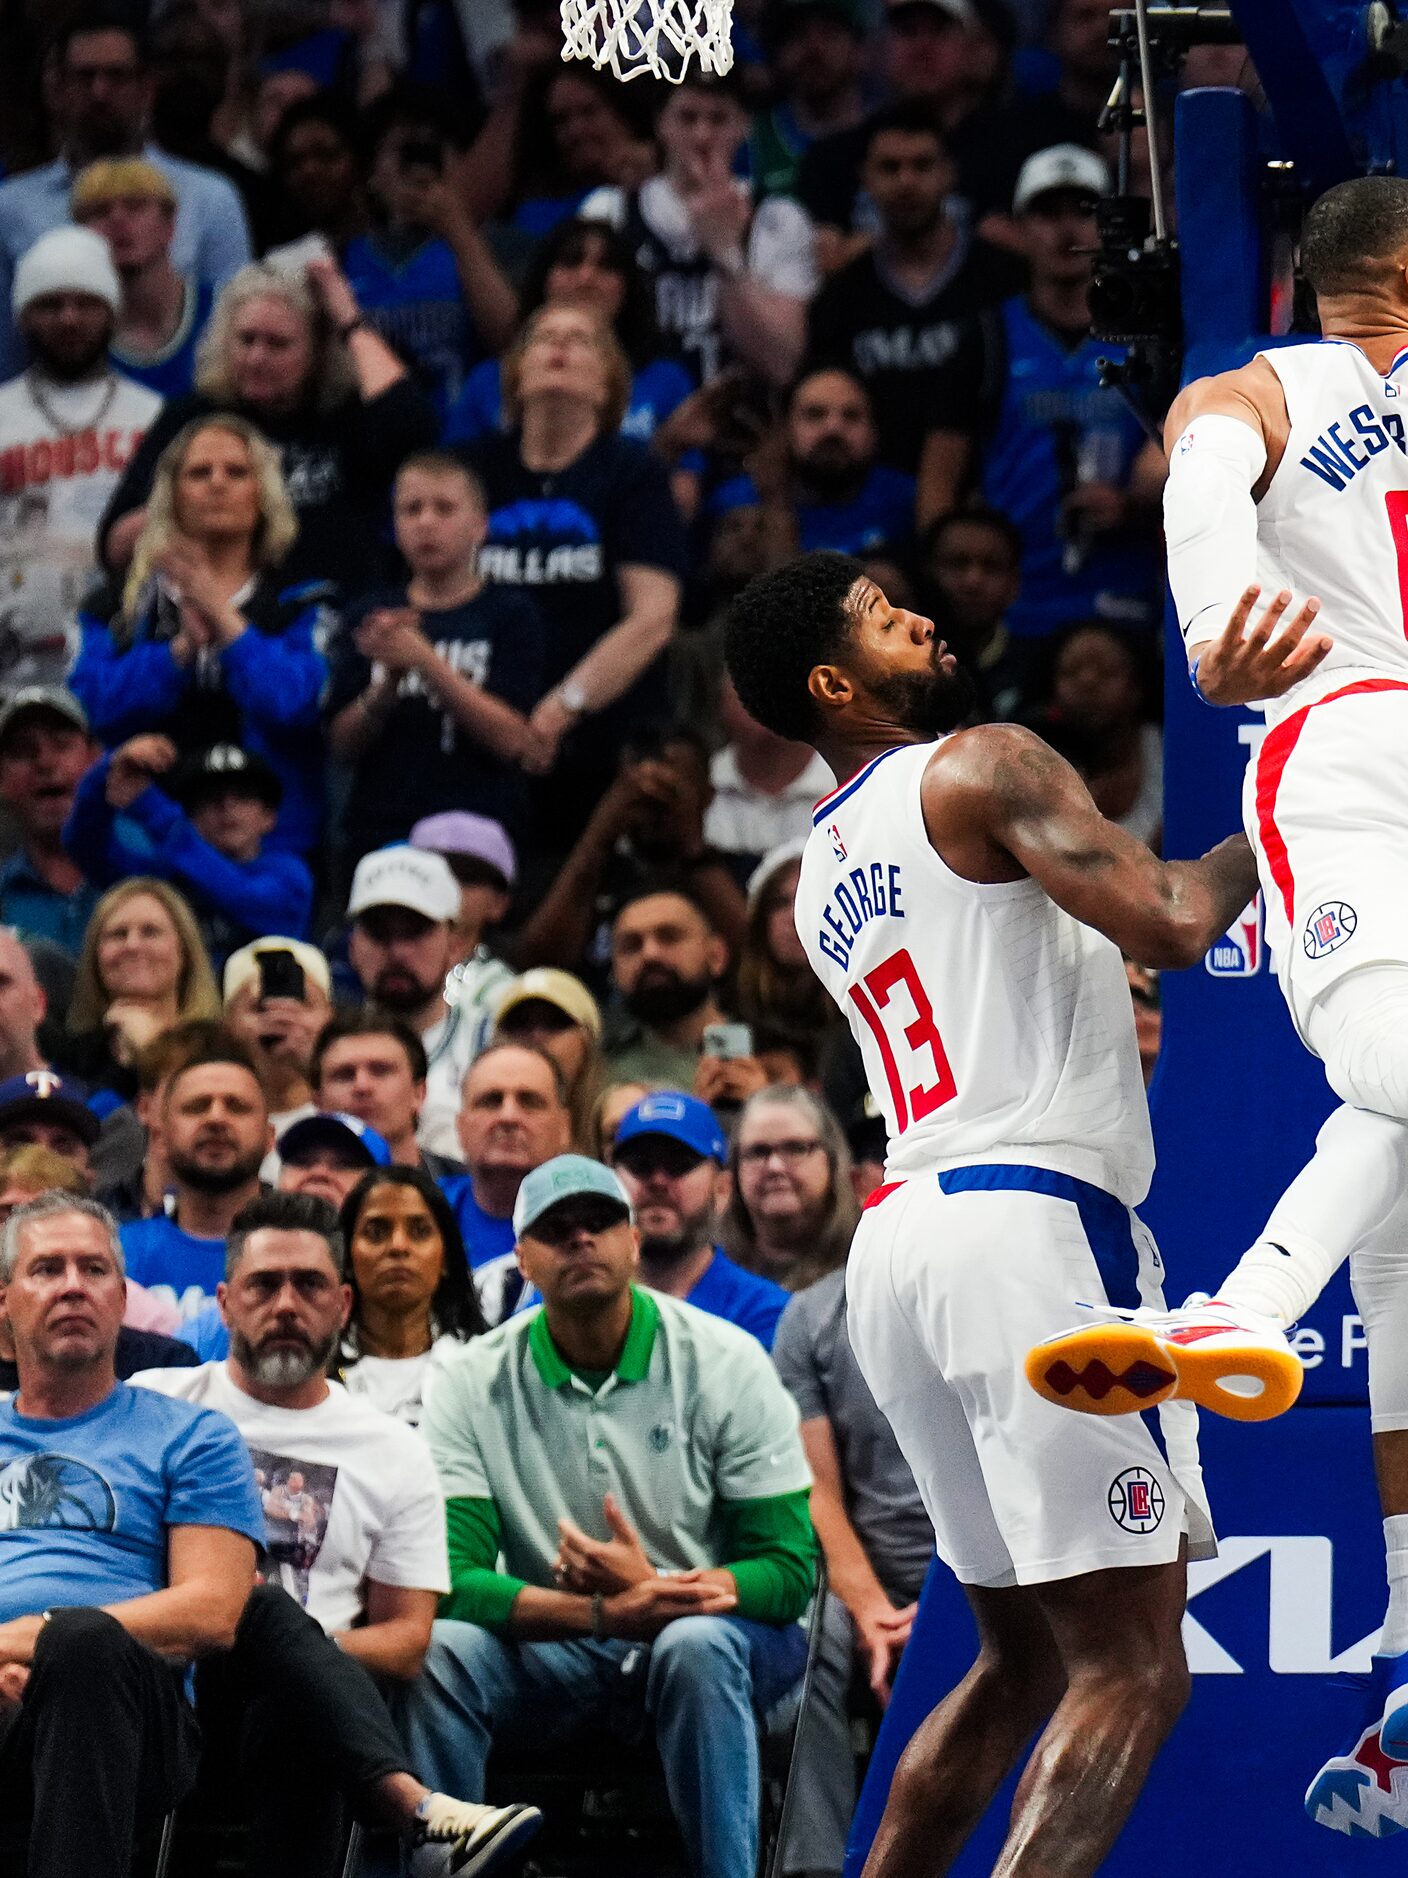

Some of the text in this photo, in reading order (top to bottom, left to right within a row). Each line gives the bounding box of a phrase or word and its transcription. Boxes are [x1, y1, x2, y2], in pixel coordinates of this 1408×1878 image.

[819, 862, 905, 973] GEORGE
[1213, 947, 1240, 968] NBA
[848, 948, 959, 1135] 13
[25, 1070, 63, 1099] T
